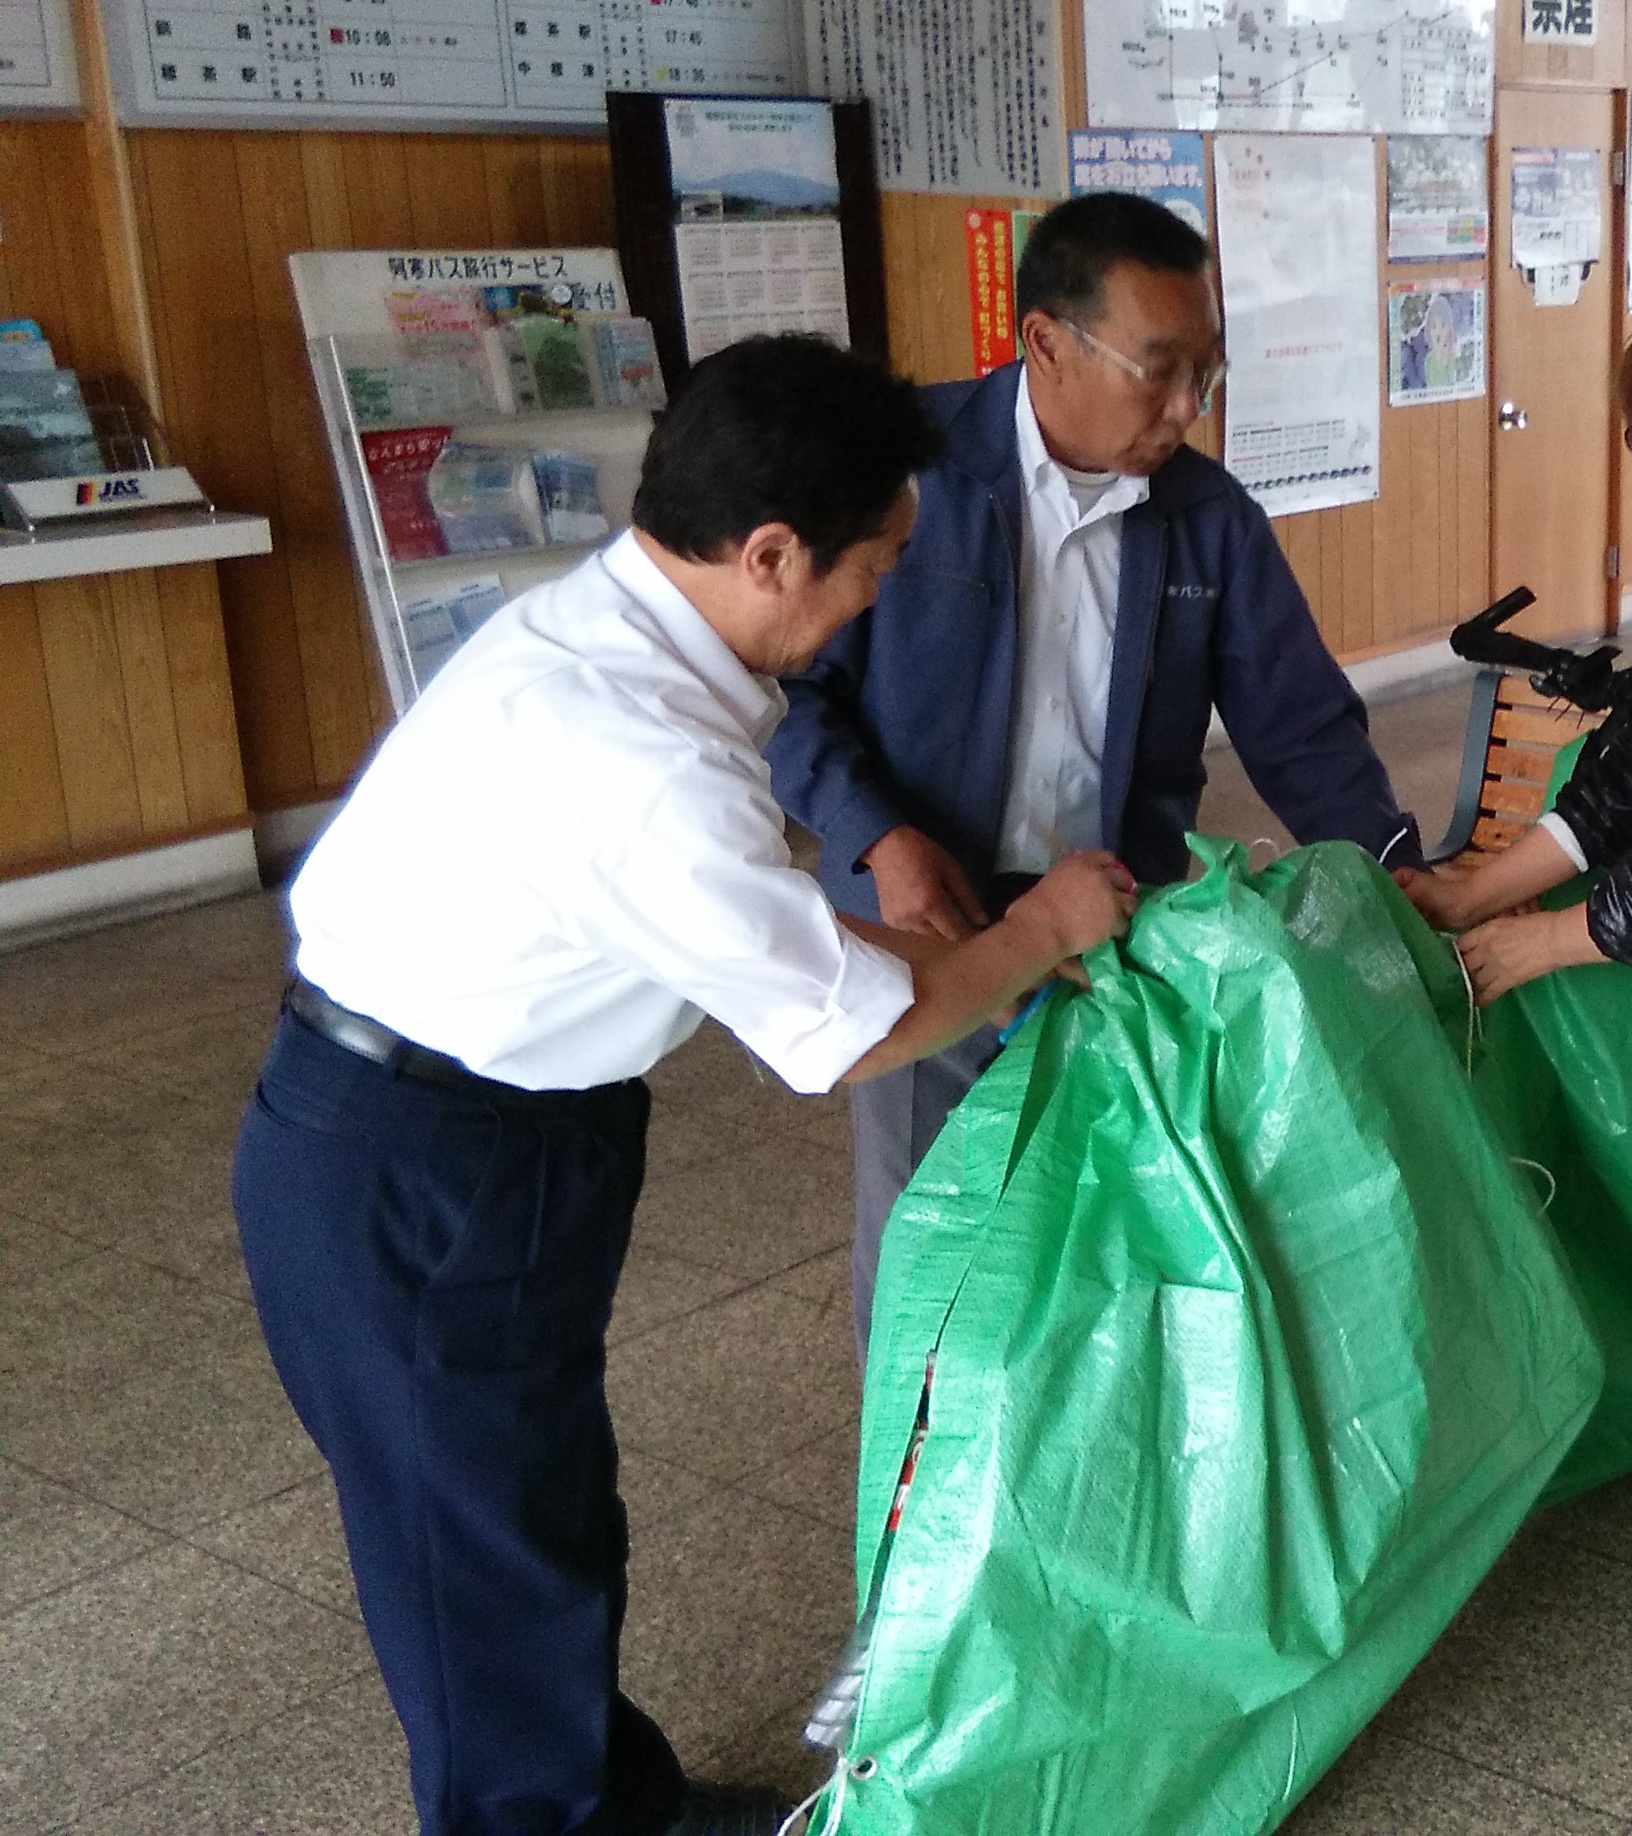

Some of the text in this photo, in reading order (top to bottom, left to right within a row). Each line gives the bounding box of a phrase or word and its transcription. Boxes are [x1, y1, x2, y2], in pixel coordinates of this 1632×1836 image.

[387, 255, 568, 282] 阿寒バス旅行サービス
[98, 478, 140, 496] JAS
